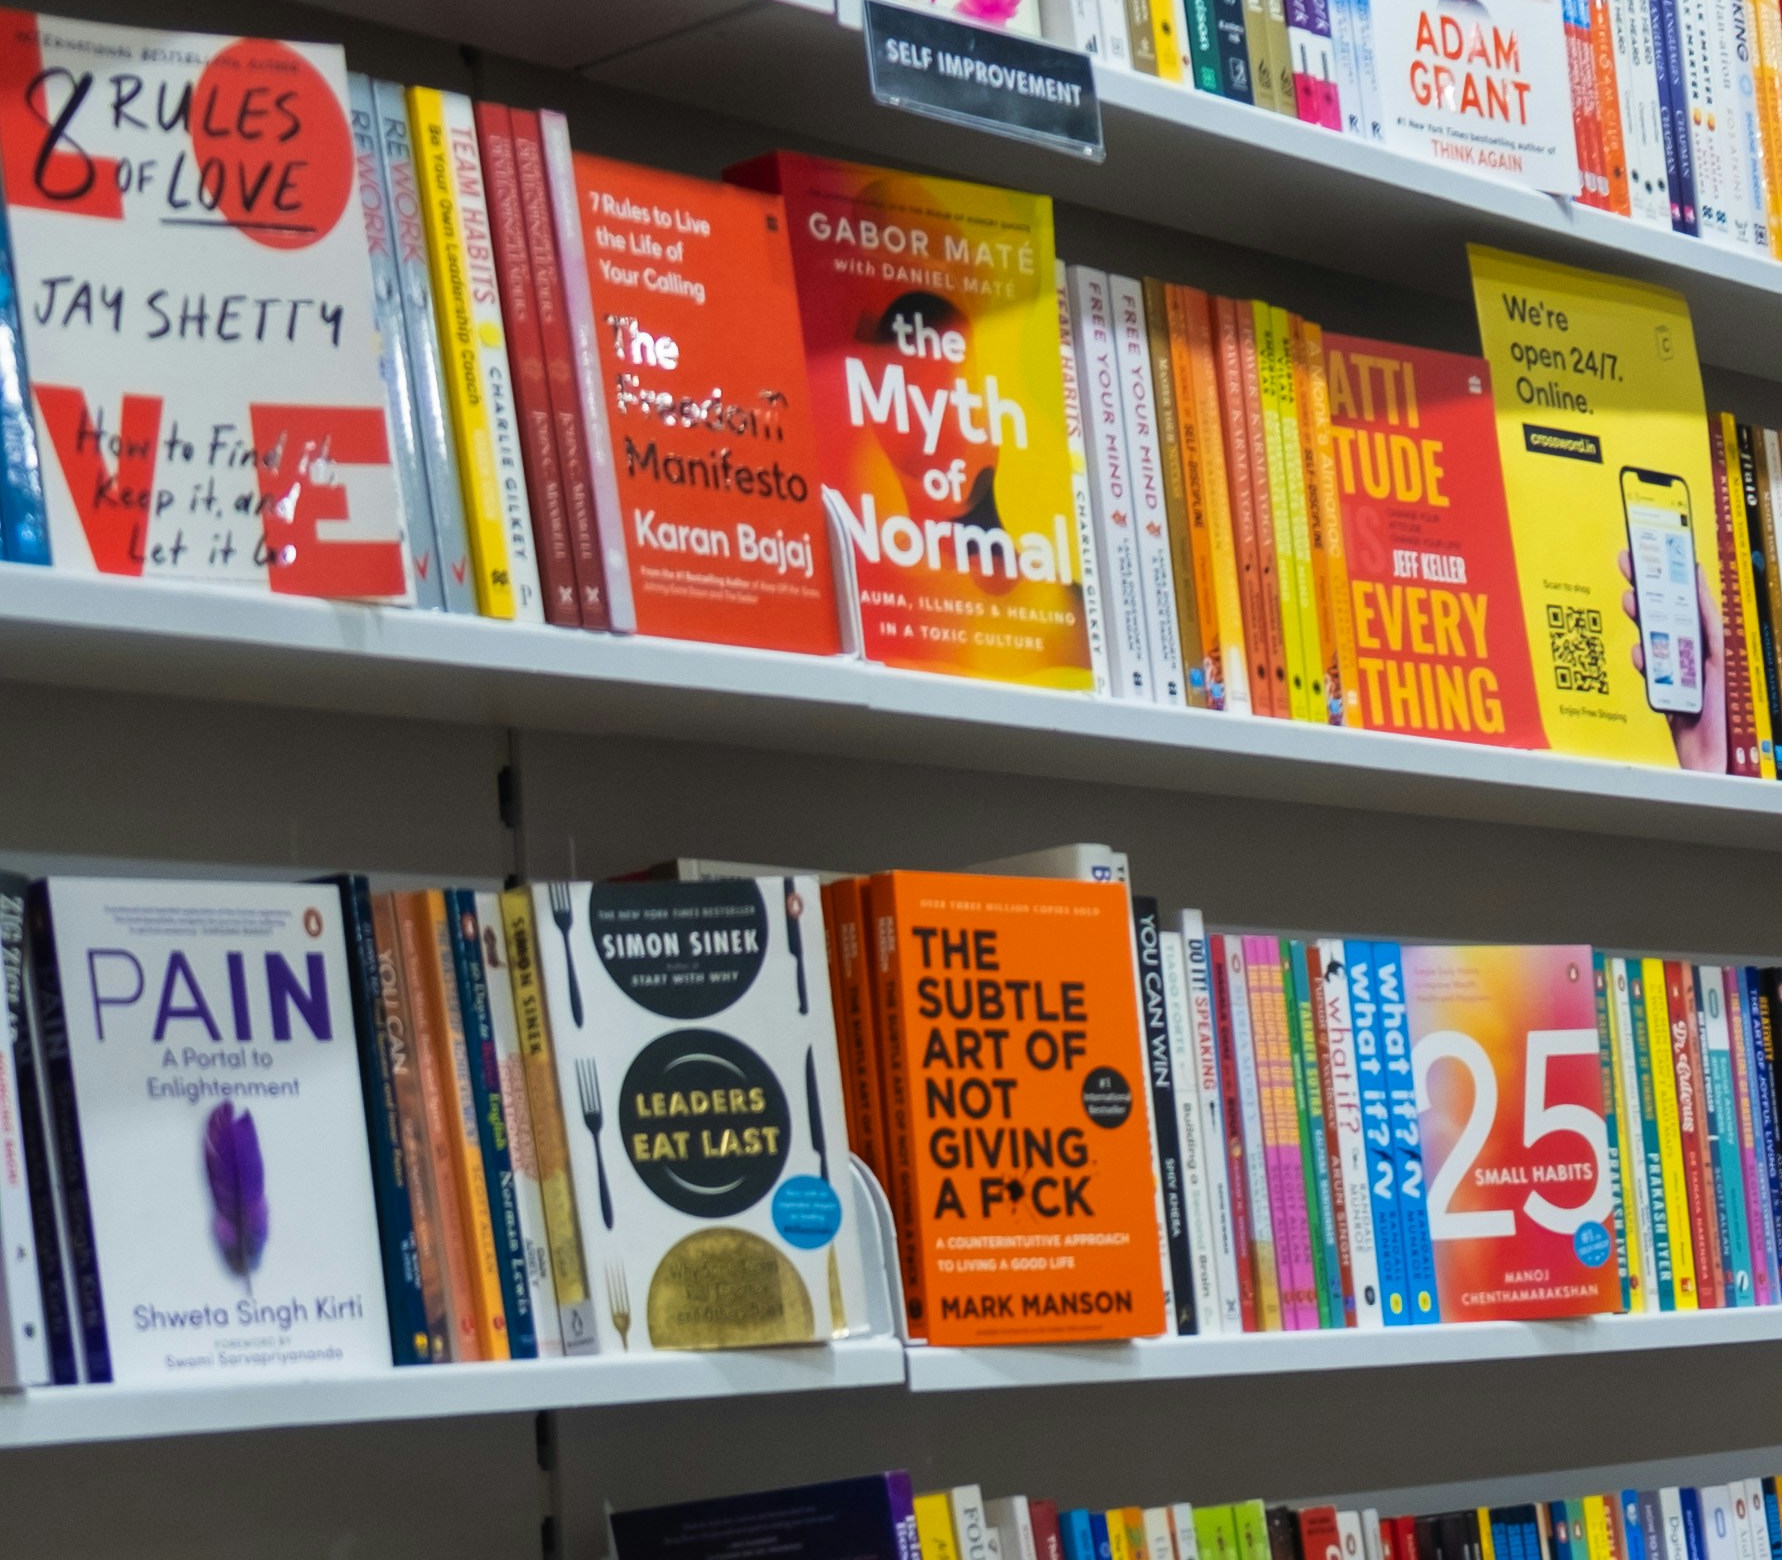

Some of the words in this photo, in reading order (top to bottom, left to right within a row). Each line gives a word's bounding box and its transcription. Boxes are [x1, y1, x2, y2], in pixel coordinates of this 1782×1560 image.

[1415, 12, 1521, 73] ADAM
[887, 39, 932, 72] SELF
[938, 52, 1083, 107] IMPROVEMENT
[1409, 59, 1530, 128] GRANT
[34, 276, 123, 333] JAY
[148, 290, 345, 347] SHETTY
[1503, 293, 1568, 332] We're
[893, 315, 965, 362] the
[1510, 341, 1567, 375] open
[1570, 348, 1623, 383] 24/7.
[844, 358, 1028, 454] Myth
[1516, 377, 1595, 416] Online.
[1530, 431, 1597, 457] crossword.in
[924, 460, 965, 502] of
[835, 489, 1073, 585] Normal
[913, 927, 999, 972] THE
[88, 949, 332, 1043] PAIN
[917, 980, 1088, 1022] SUBTLE
[922, 1031, 1006, 1070] ART
[1027, 1031, 1087, 1070] OF
[636, 1088, 766, 1118] LEADERS
[926, 1079, 1017, 1119] NOT
[633, 1130, 690, 1161] EAT
[702, 1127, 780, 1158] LAST
[929, 1129, 1088, 1168] GIVING
[1475, 1166, 1528, 1186] SMALL
[1532, 1163, 1593, 1182] HABITS
[940, 1294, 1014, 1320] MARK
[1021, 1290, 1133, 1316] MANSON
